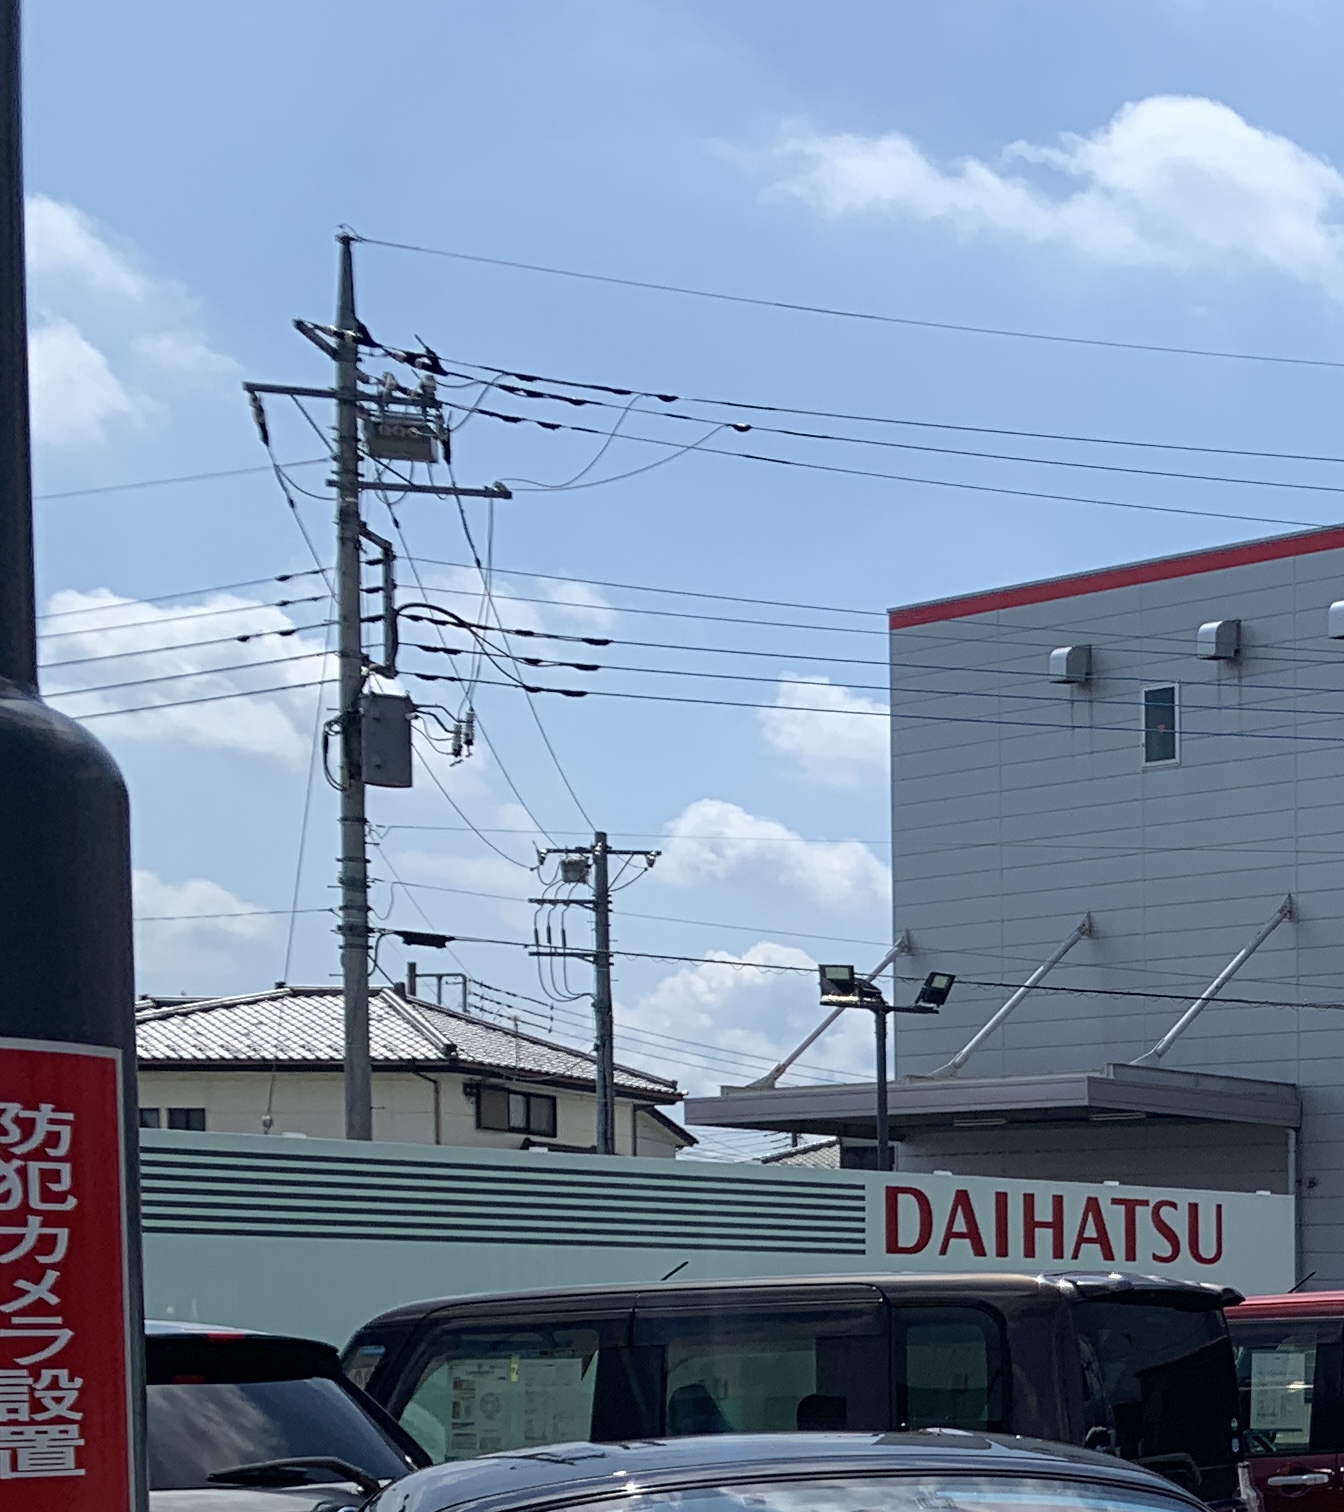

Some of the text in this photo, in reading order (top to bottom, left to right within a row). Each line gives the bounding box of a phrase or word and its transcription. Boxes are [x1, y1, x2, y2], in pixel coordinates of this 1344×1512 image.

[0, 1102, 87, 1478] 防犯カメラ設置
[885, 1186, 1224, 1265] DAIHATSU
